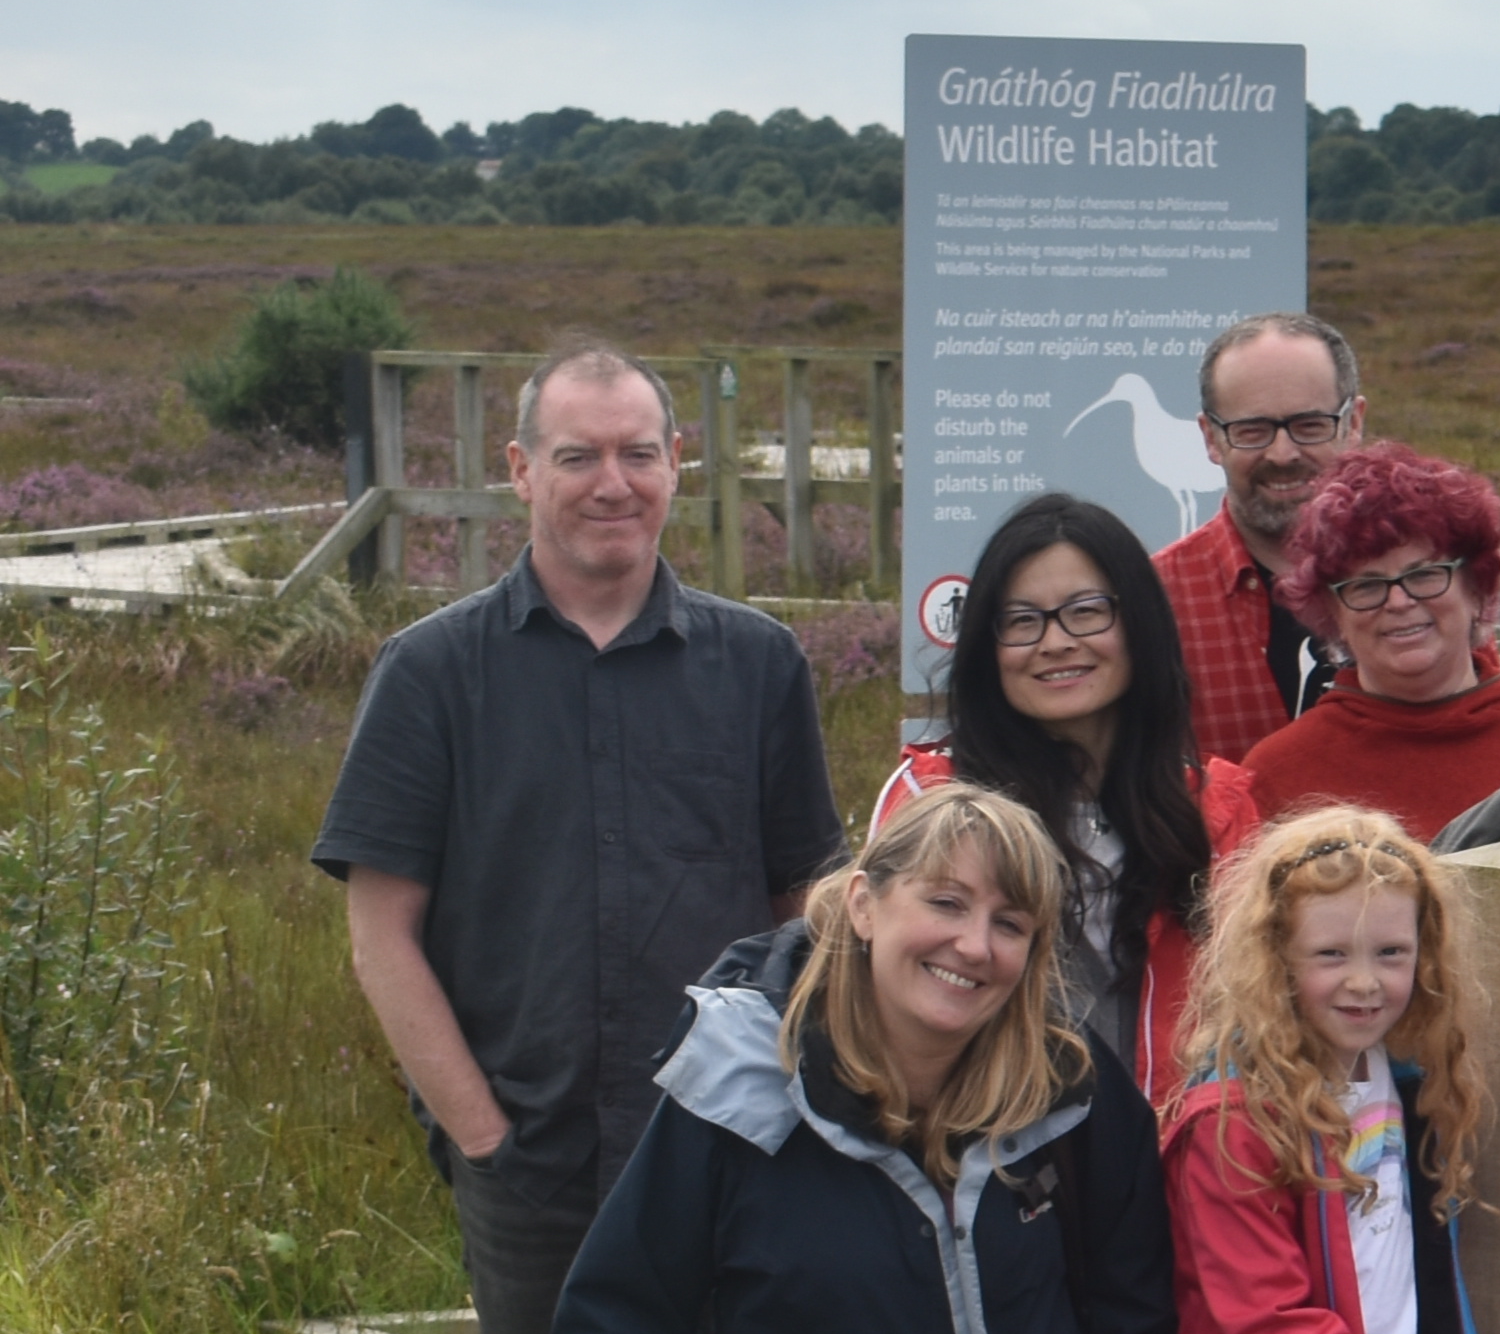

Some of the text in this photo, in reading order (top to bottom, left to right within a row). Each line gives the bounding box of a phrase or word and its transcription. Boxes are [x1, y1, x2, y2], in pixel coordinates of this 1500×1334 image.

[939, 66, 1277, 118] Gnáthóg Fiadhúlra
[937, 124, 1218, 168] Wildlife Habitat
[934, 309, 959, 327] Na
[964, 309, 997, 327] cuir
[999, 309, 1060, 327] isteach
[1063, 314, 1083, 327] ar
[1086, 314, 1106, 328] na
[934, 337, 1002, 358] plandaí
[1004, 341, 1035, 355] san
[1039, 337, 1099, 360] reigiún
[1102, 341, 1138, 358] seo,
[1142, 338, 1159, 356] le
[1162, 338, 1185, 356] do
[934, 389, 1052, 408] Please do not
[934, 417, 1028, 437] disturb the
[934, 445, 1025, 465] animals or
[934, 473, 1046, 496] plants in this
[934, 506, 977, 521] area.
